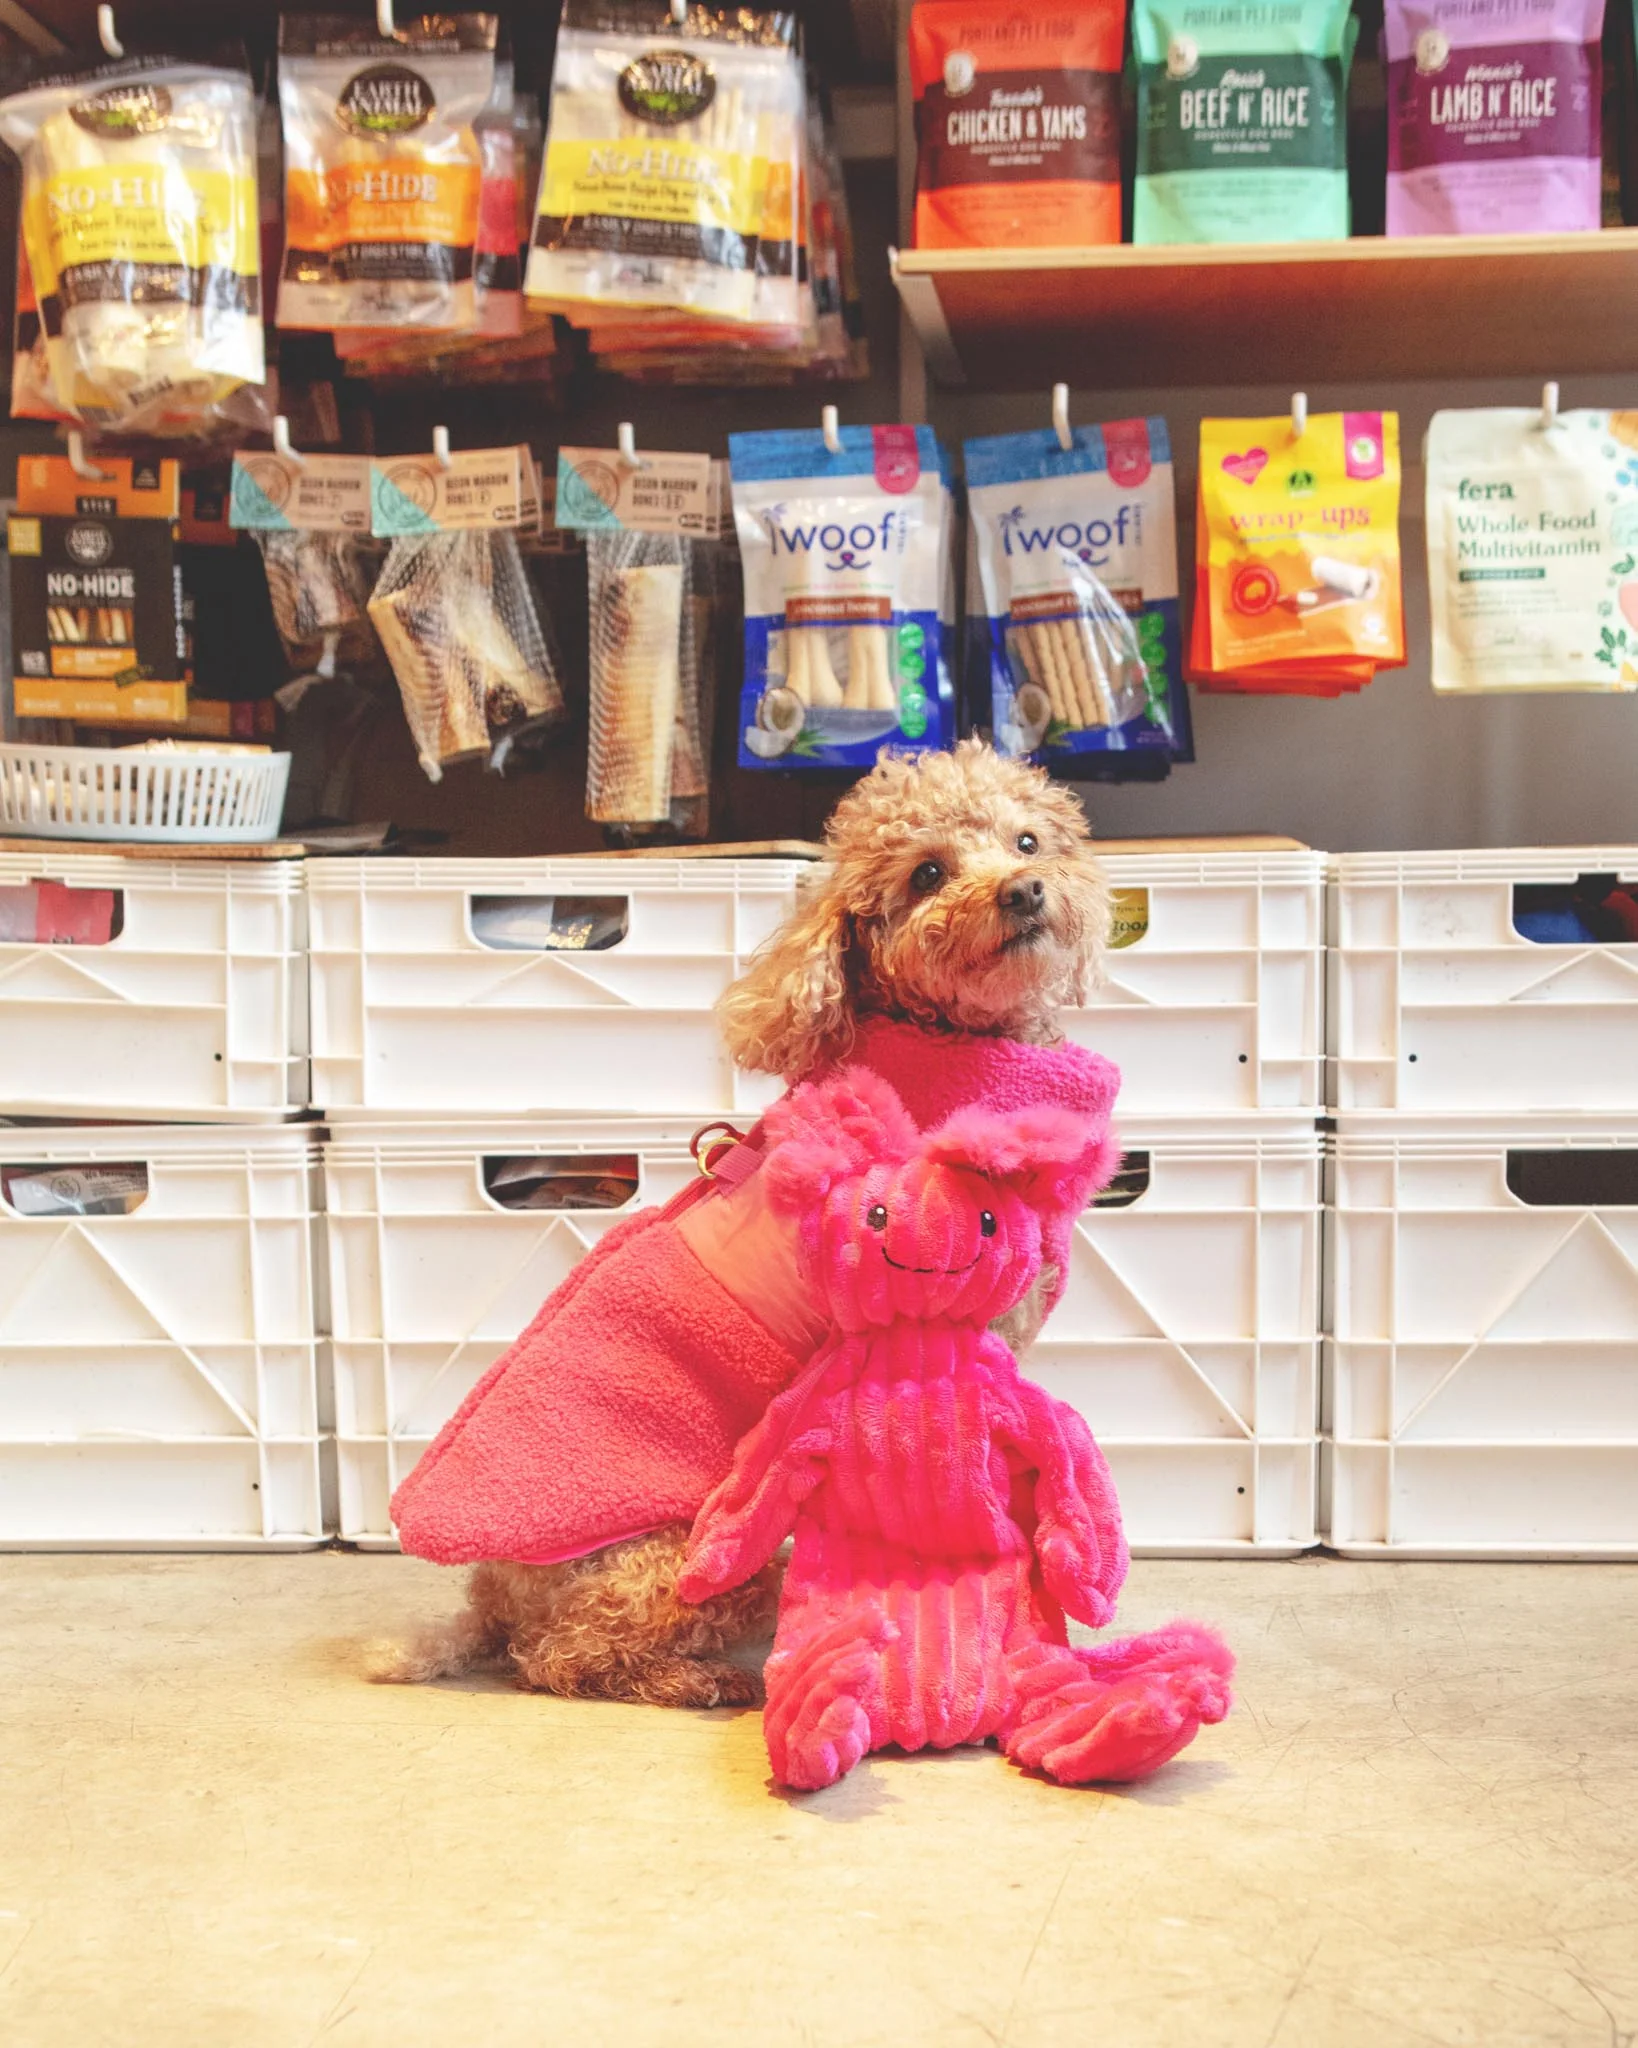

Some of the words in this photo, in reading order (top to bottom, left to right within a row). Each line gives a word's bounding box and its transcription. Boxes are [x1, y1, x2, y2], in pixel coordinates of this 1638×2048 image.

[353, 79, 421, 98] EARTH
[349, 97, 425, 116] ANIMAL
[1180, 89, 1233, 130] BEEF
[1261, 87, 1310, 127] RICE
[1430, 83, 1484, 125] LAMB
[1510, 77, 1557, 118] RICE
[947, 107, 1022, 146] CHICKEN
[1041, 105, 1087, 140] YAMS
[1457, 478, 1516, 500] fera
[1457, 513, 1530, 534] Whole
[1539, 508, 1597, 532] Food
[1458, 537, 1601, 560] Multivitamin
